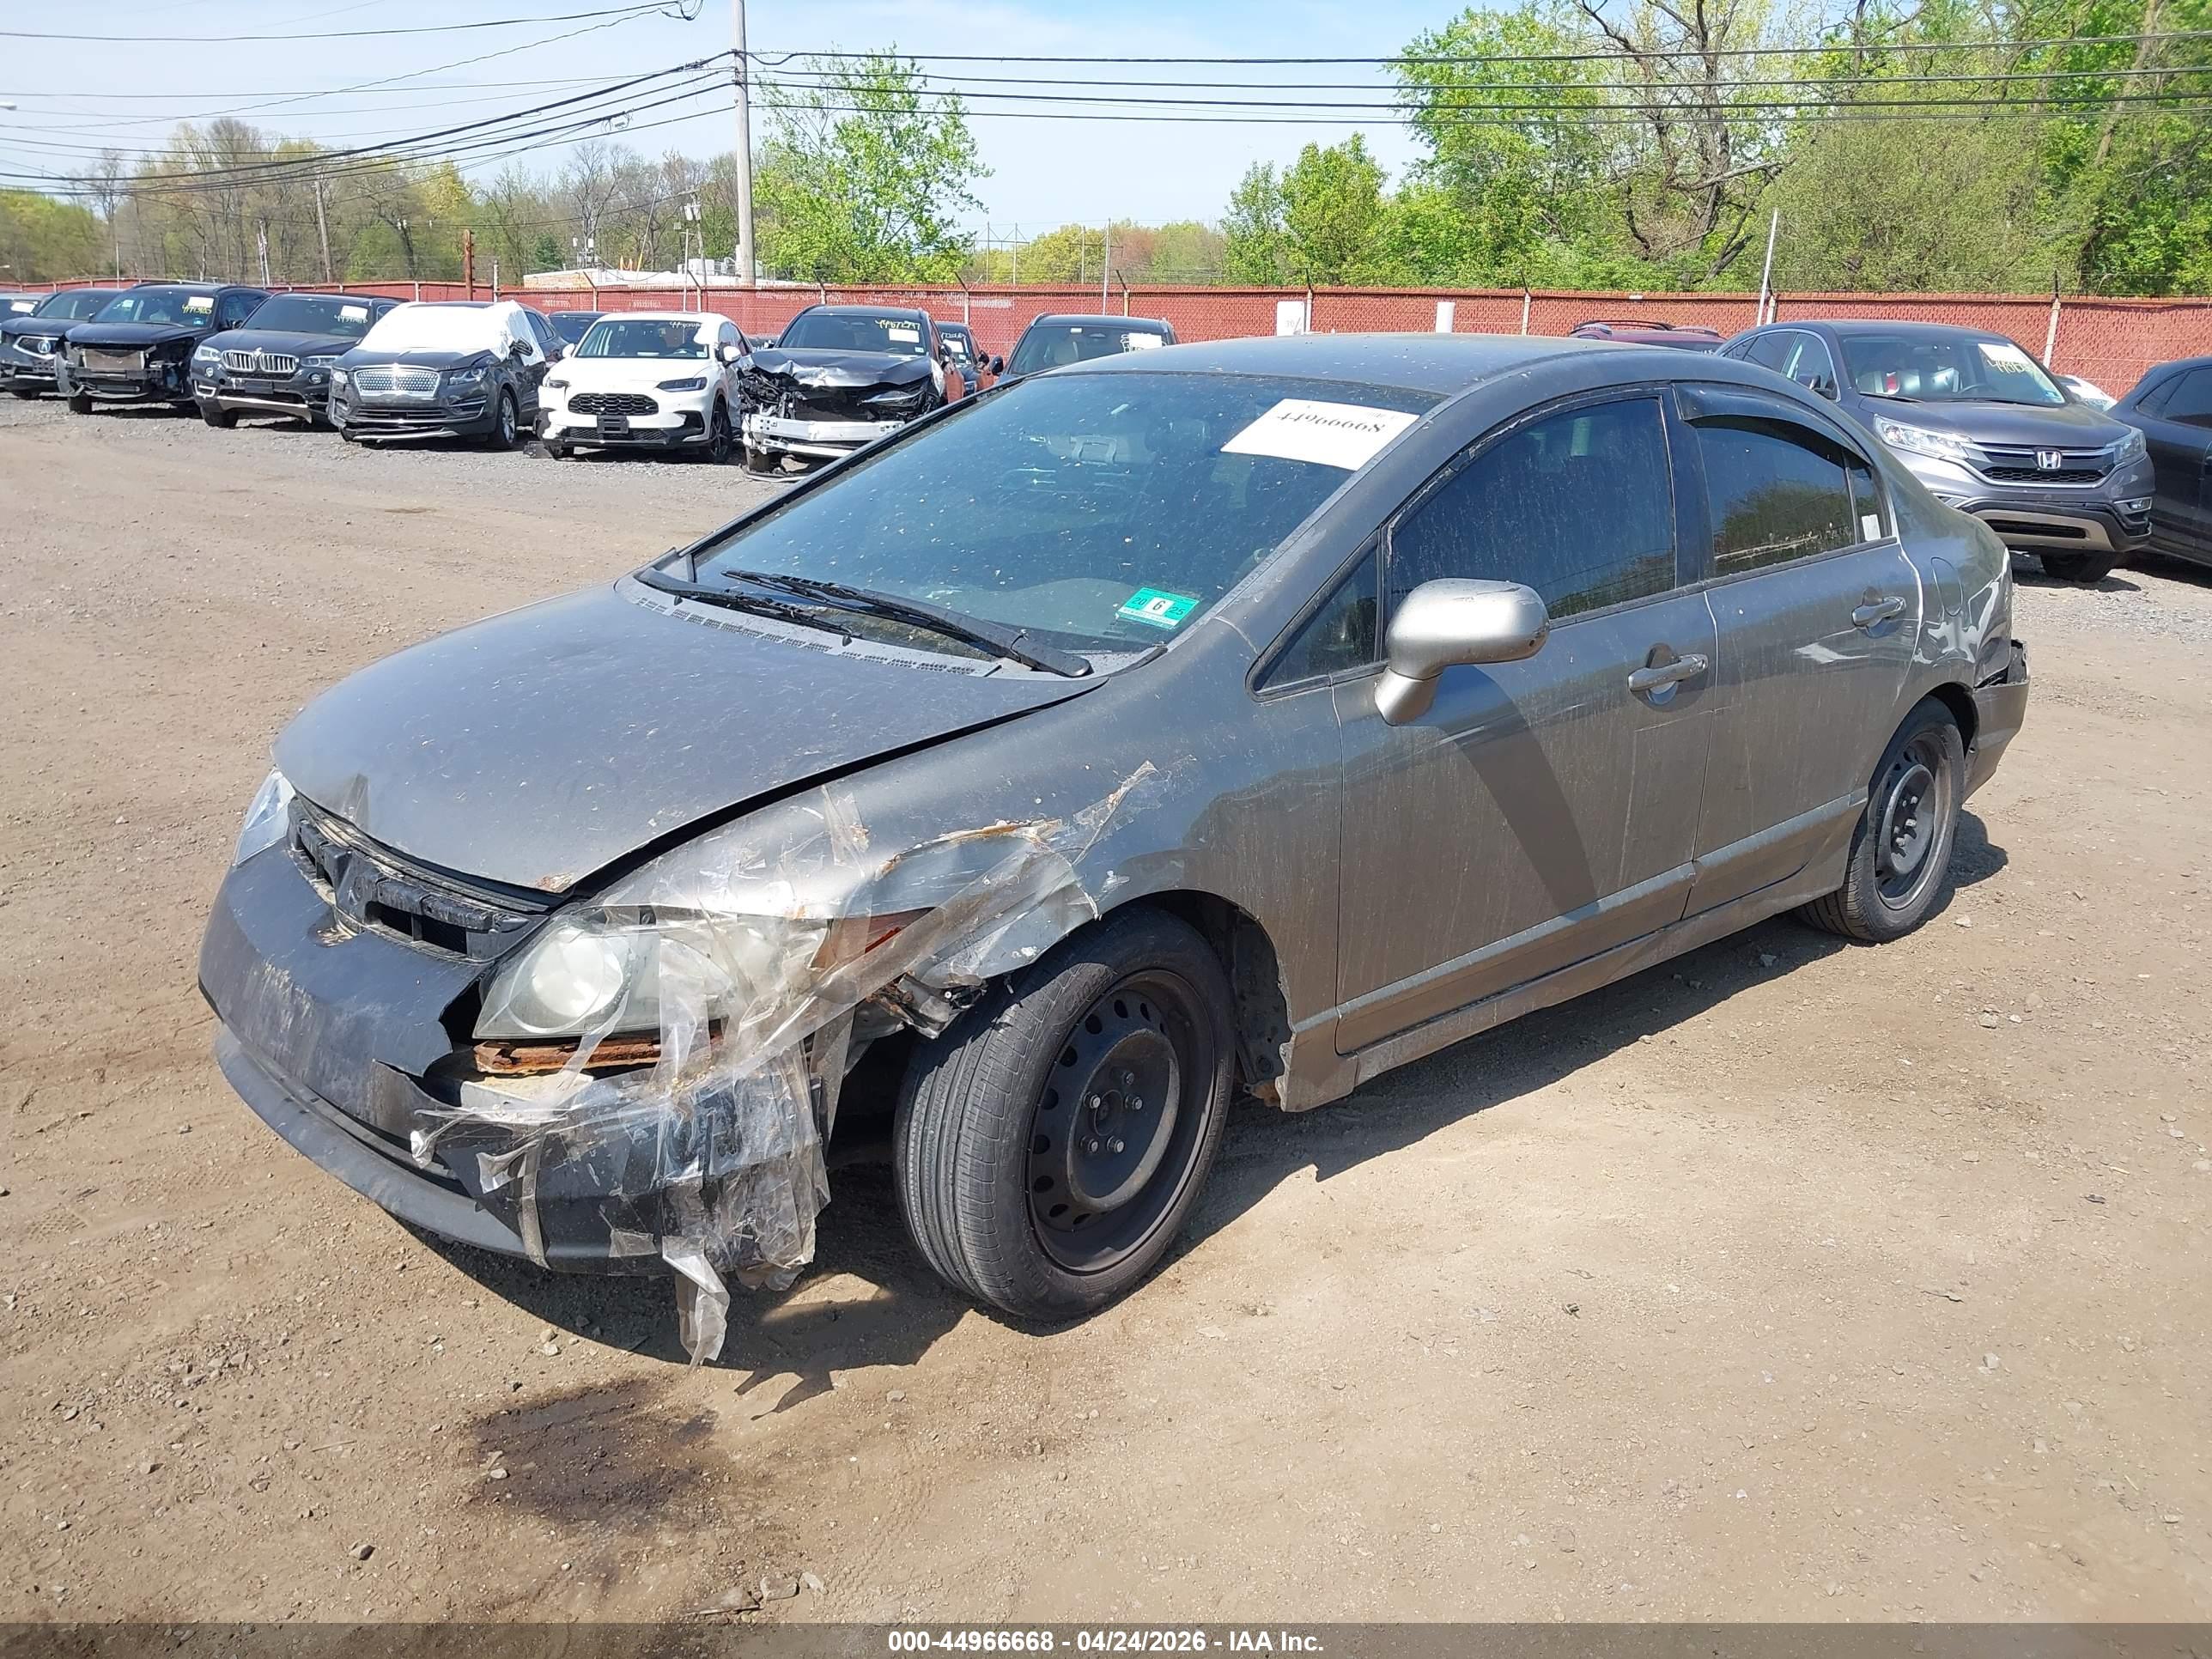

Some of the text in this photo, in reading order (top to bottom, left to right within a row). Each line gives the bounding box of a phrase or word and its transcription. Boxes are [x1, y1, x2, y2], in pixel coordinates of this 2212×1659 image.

[1277, 411, 1386, 433] 44966668
[1132, 597, 1186, 616] 20 6 25
